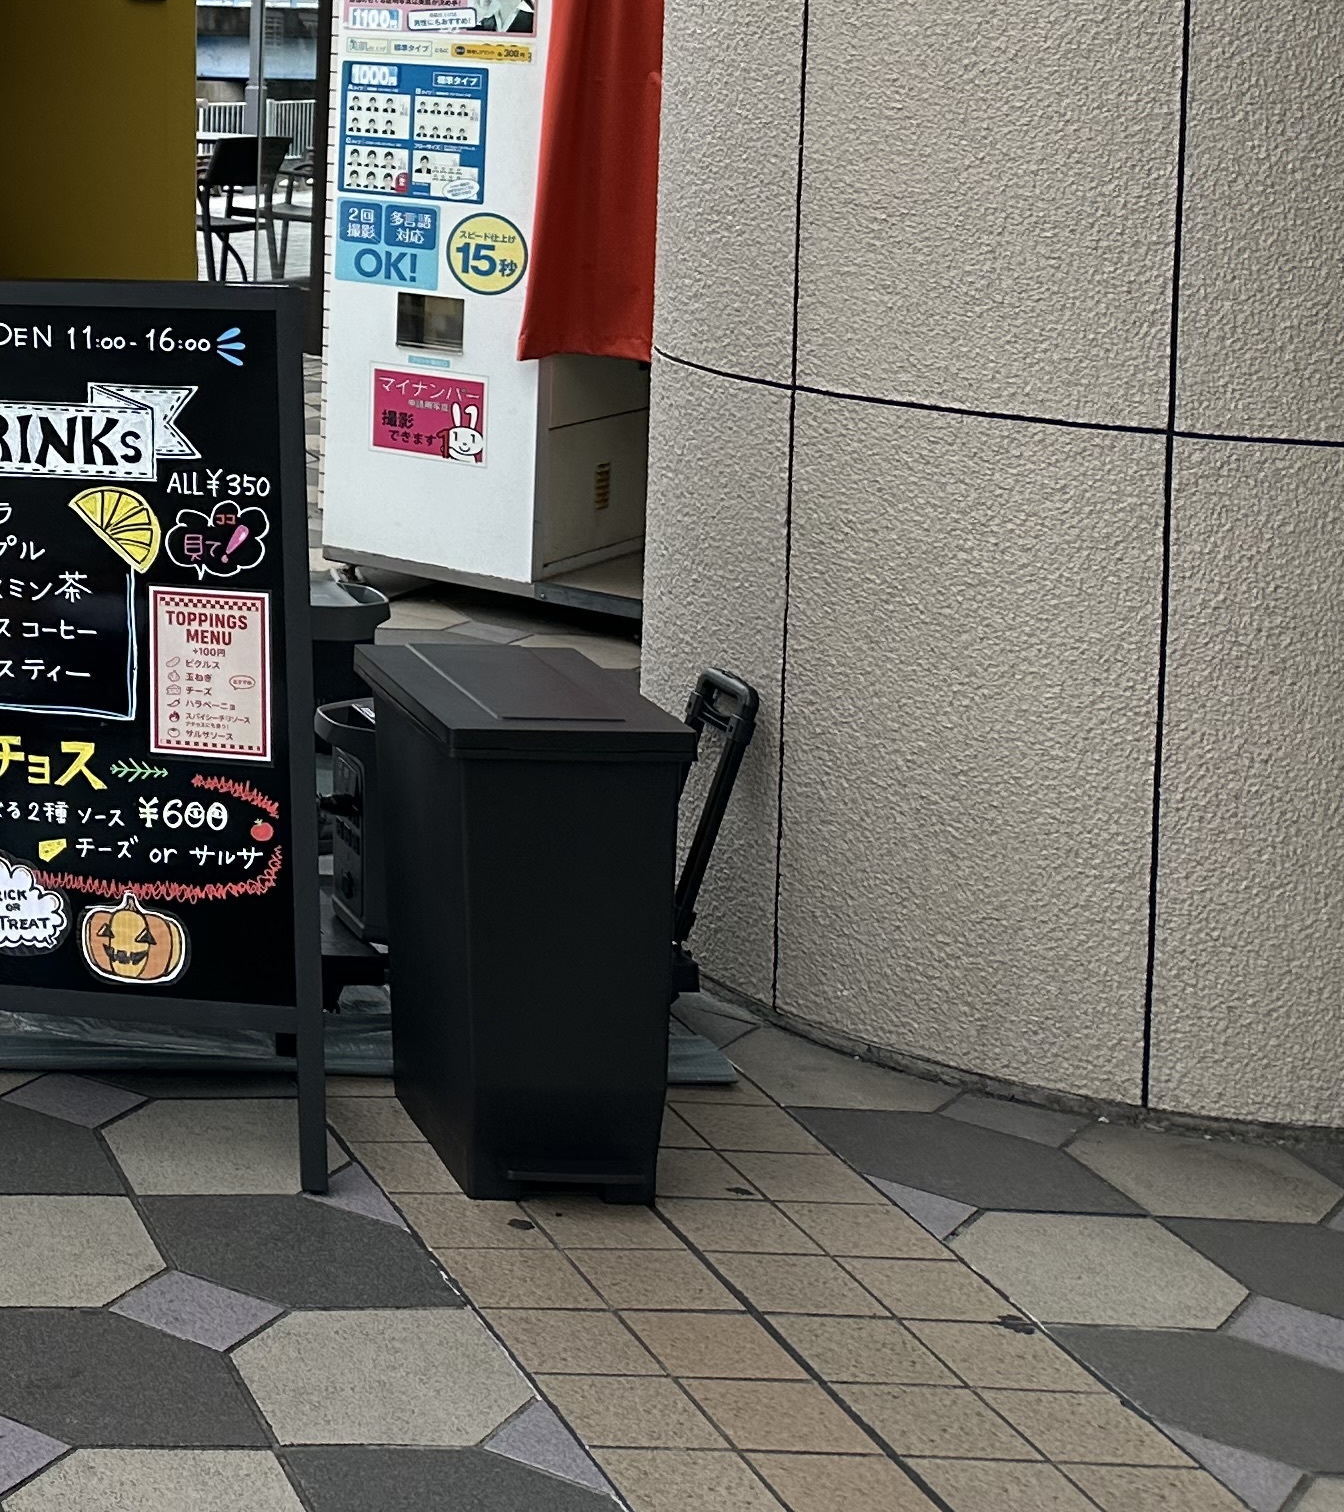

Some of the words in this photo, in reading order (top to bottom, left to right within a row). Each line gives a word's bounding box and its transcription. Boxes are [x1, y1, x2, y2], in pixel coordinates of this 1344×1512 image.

[348, 208, 374, 223] 2回
[354, 248, 418, 283] OK!
[456, 242, 518, 277] 15秒
[378, 376, 480, 402] マイナンバー
[389, 430, 436, 447] できます
[165, 610, 248, 630] TOPPINGS
[186, 629, 232, 646] MENU
[139, 797, 229, 831] ¥600
[75, 836, 138, 859] チーズ
[149, 847, 178, 864] or
[189, 846, 264, 870] サルサ
